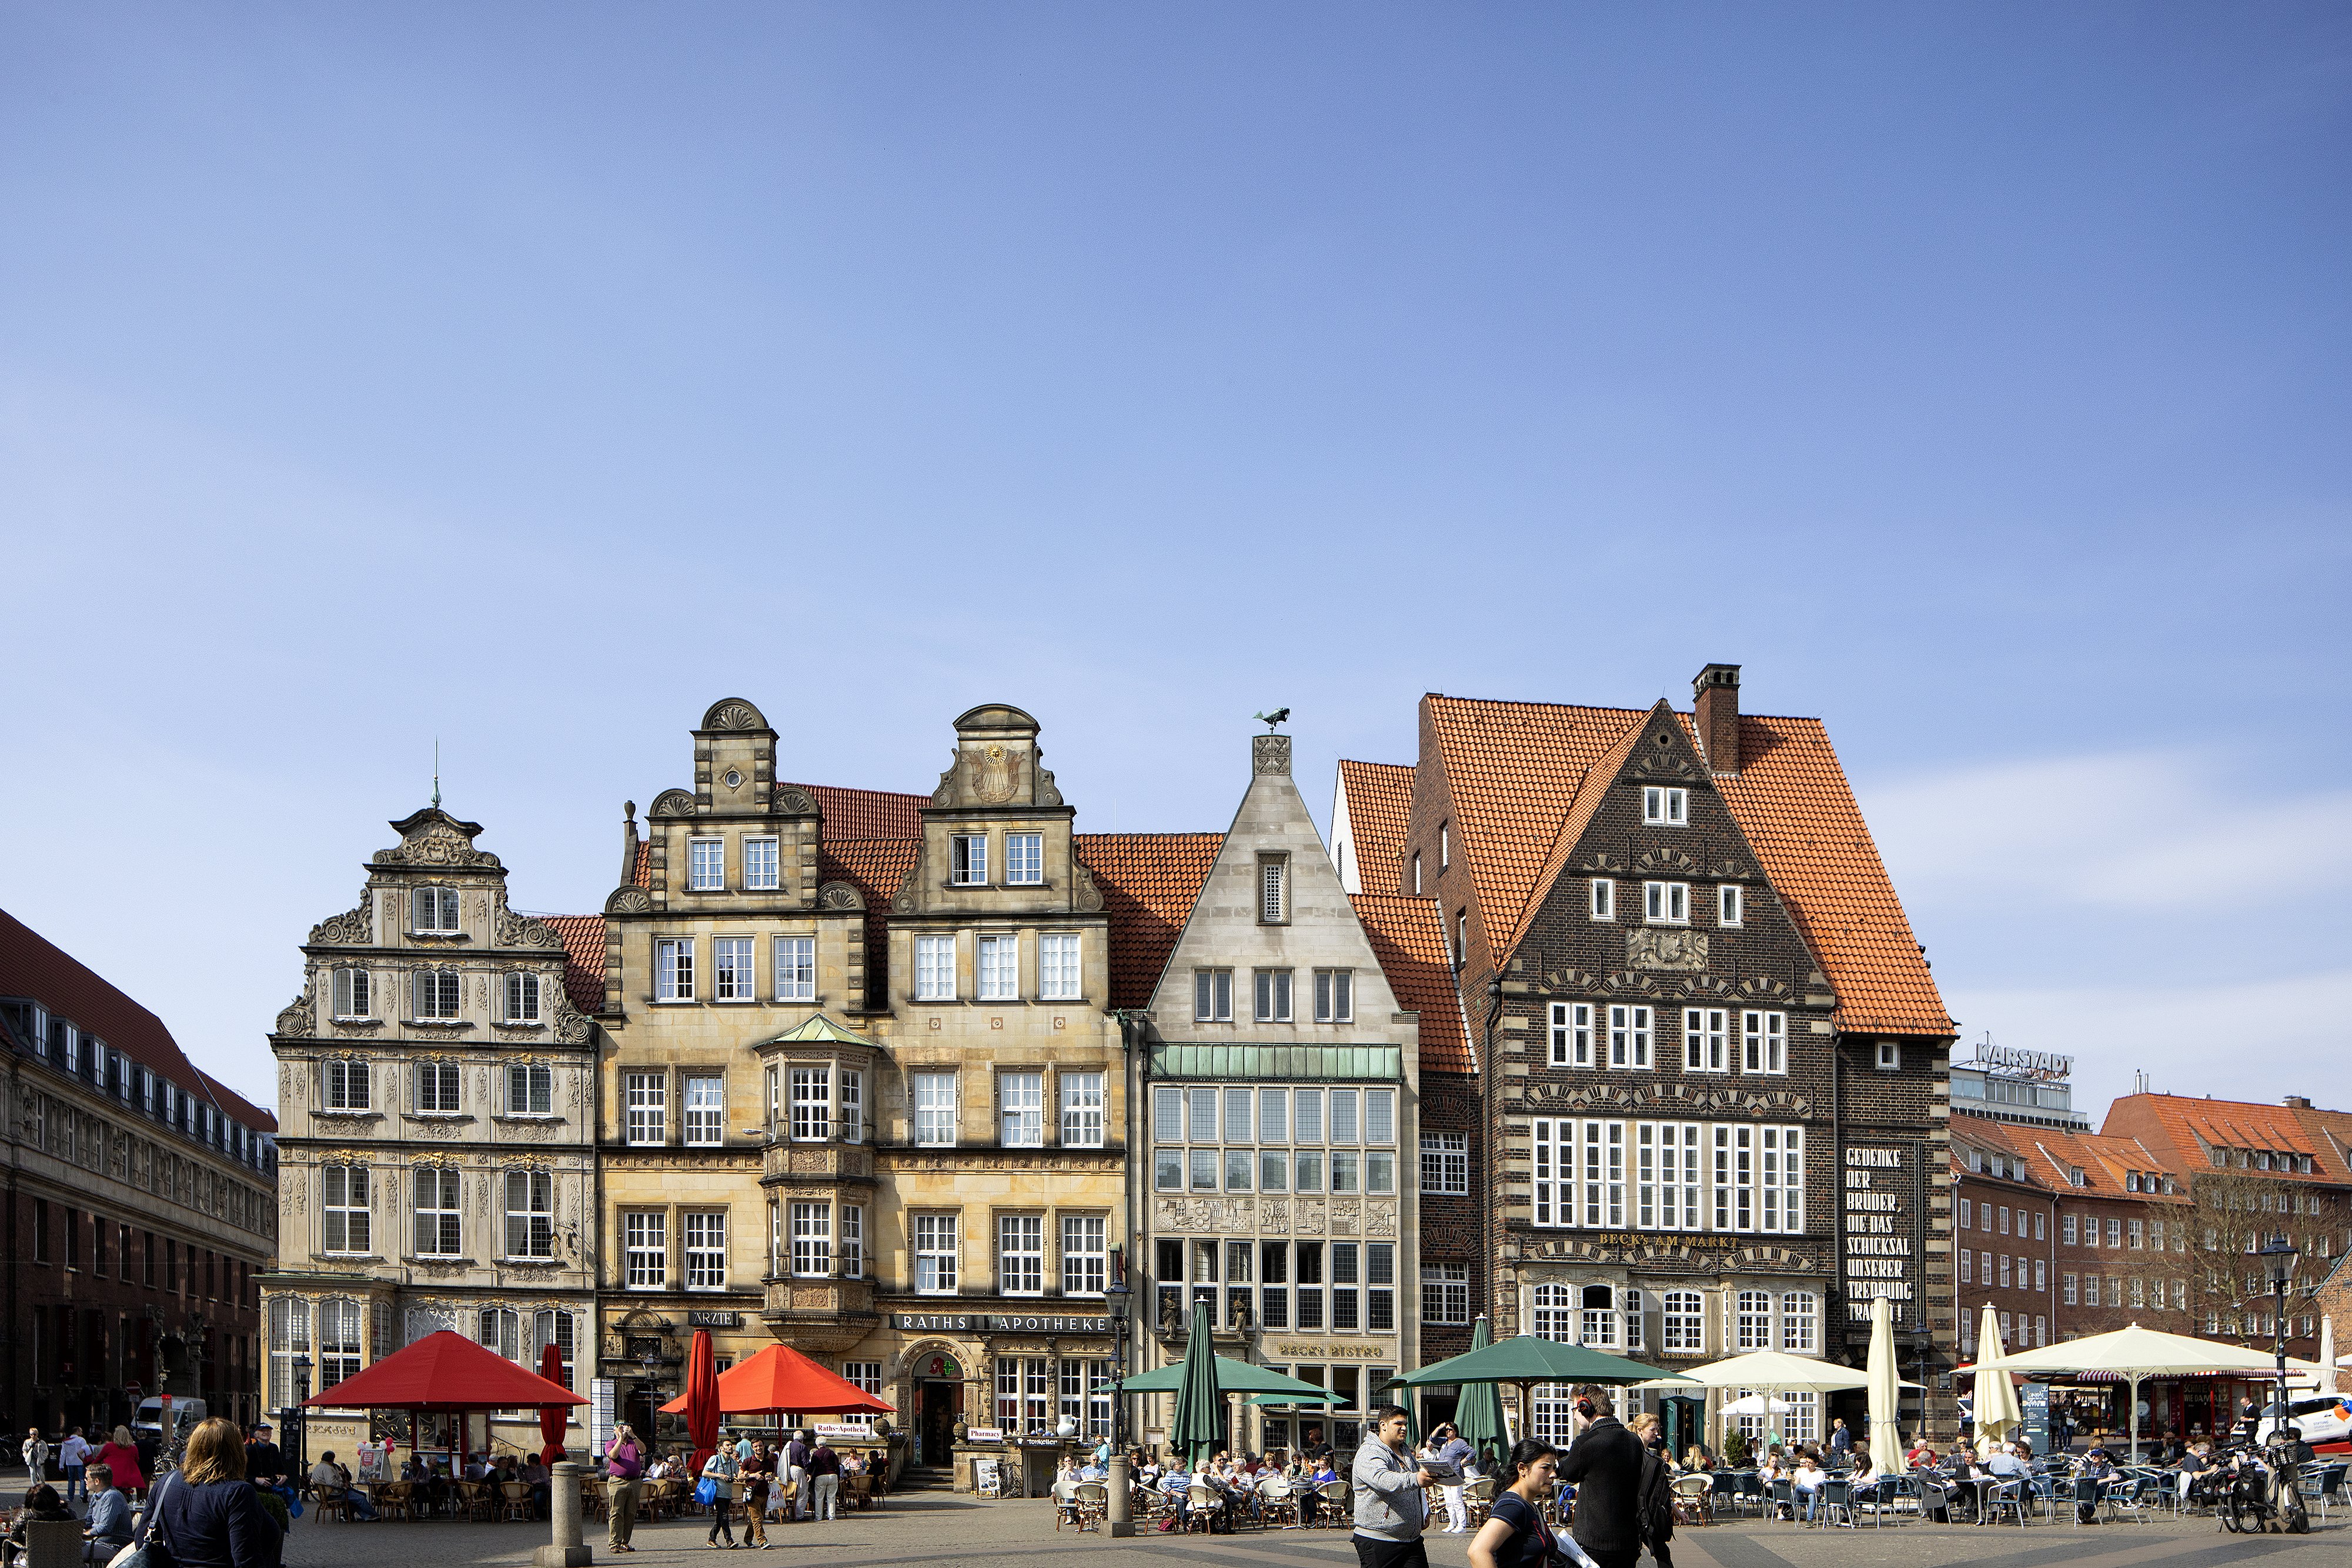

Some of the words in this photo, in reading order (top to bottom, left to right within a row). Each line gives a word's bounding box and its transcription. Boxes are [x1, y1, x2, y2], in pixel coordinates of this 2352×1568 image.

[1976, 1044, 2074, 1074] KARSTADT
[1846, 1148, 1900, 1167] GEDENKE
[1846, 1171, 1870, 1188] DER
[1846, 1190, 1902, 1212] BRÜDER,
[1847, 1215, 1866, 1232] DIE
[1870, 1216, 1893, 1233] DAS
[1655, 1236, 1678, 1246] AM
[1685, 1236, 1739, 1248] MARKT
[1847, 1237, 1910, 1255] SCHICKSAL
[1847, 1259, 1903, 1277] UNSERER
[1847, 1281, 1912, 1299] TRENNUNG
[694, 1312, 731, 1324] ÄRZTE
[1848, 1303, 1893, 1321] TRAGN
[903, 1316, 966, 1329] RATHS
[1000, 1318, 1105, 1330] APOTHEKE
[1329, 1345, 1383, 1358] BISTRO
